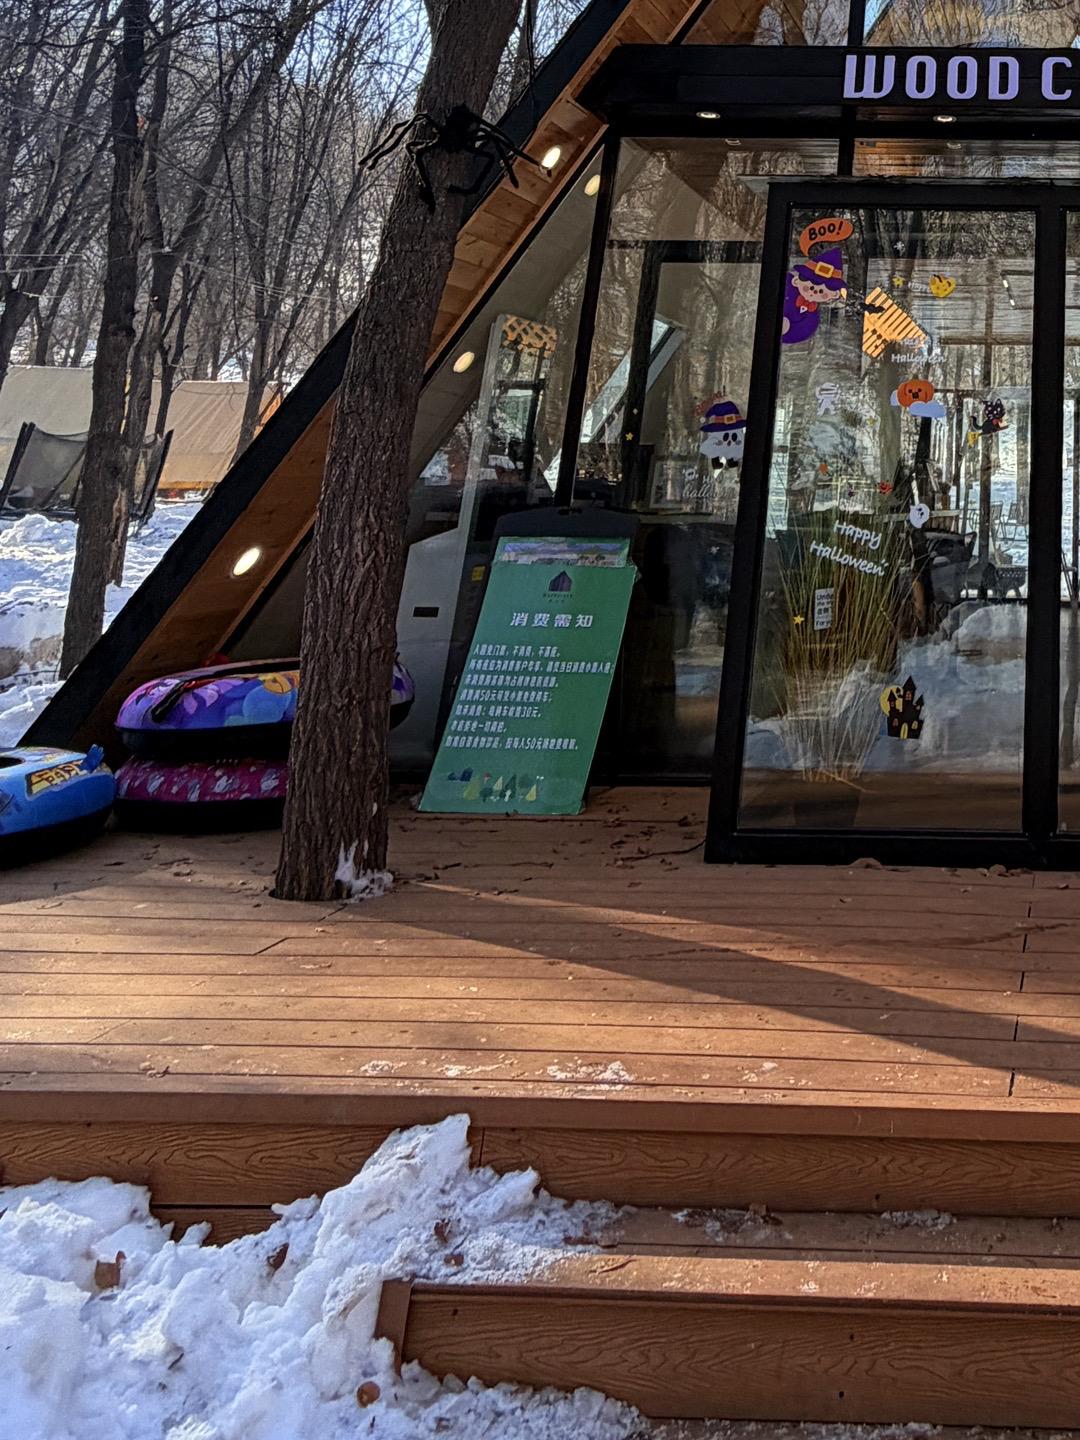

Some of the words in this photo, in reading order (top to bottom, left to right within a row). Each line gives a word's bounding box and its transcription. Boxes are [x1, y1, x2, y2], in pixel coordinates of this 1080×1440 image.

[843, 54, 1019, 101] WOOD
[808, 221, 843, 240] BOO!
[833, 520, 882, 550] Happy
[810, 540, 886, 577] Halloween
[510, 612, 593, 628] 消费需知
